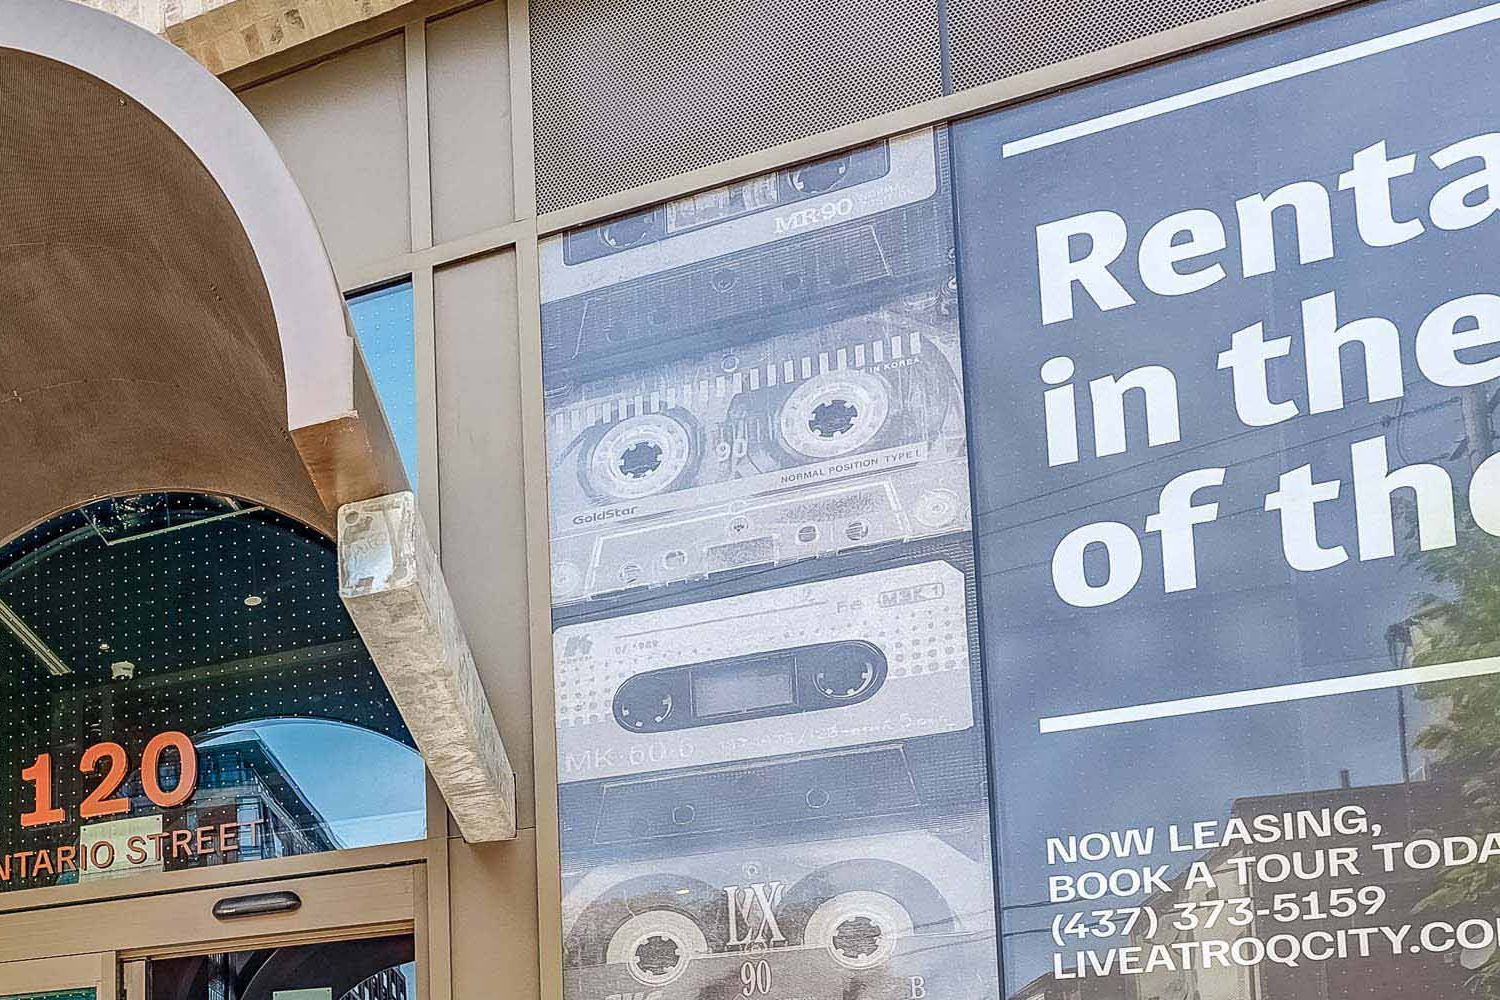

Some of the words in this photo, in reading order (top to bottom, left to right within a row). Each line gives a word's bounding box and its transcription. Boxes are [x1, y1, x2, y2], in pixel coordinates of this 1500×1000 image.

[1040, 355, 1182, 467] in
[781, 469, 825, 484] NORMAL
[828, 457, 878, 476] POSITION
[884, 451, 913, 464] TYPE
[572, 506, 638, 525] GoldStar
[1051, 467, 1227, 608] of
[20, 731, 198, 828] 120
[126, 818, 266, 866] STREET
[1046, 827, 1155, 865] NOW
[1168, 805, 1382, 852] LEASING,
[1049, 864, 1173, 903] BOOK
[1184, 861, 1217, 891] A
[1227, 847, 1361, 886] TOUR
[1051, 906, 1159, 947] (437)
[1172, 885, 1387, 931] 373-5159
[1053, 917, 1500, 980] LIVEATROQCITY.CO
[740, 959, 773, 997] 90
[910, 976, 926, 1000] B
